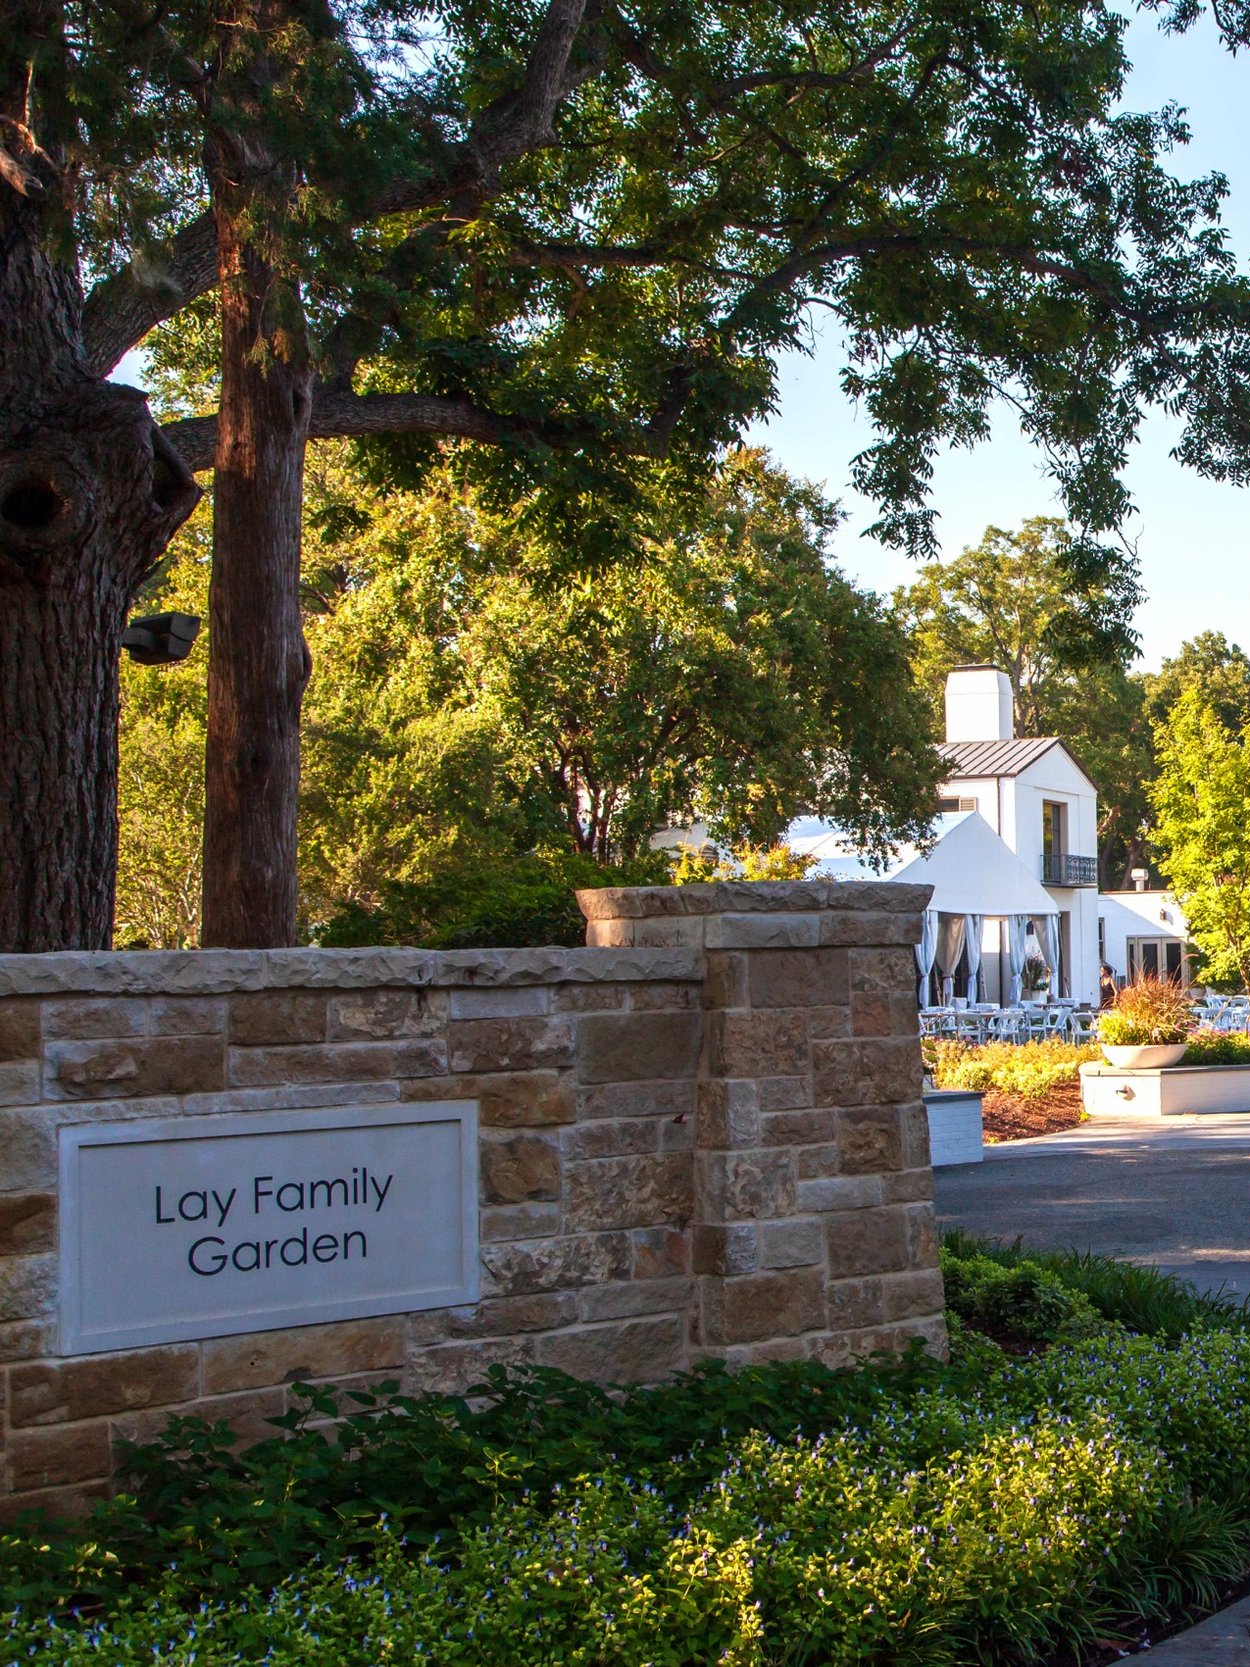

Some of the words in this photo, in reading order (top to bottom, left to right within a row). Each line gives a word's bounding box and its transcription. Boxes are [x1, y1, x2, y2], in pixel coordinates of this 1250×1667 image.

[155, 1185, 237, 1228] Lay
[253, 1166, 394, 1215] Family
[187, 1226, 368, 1277] Garden
